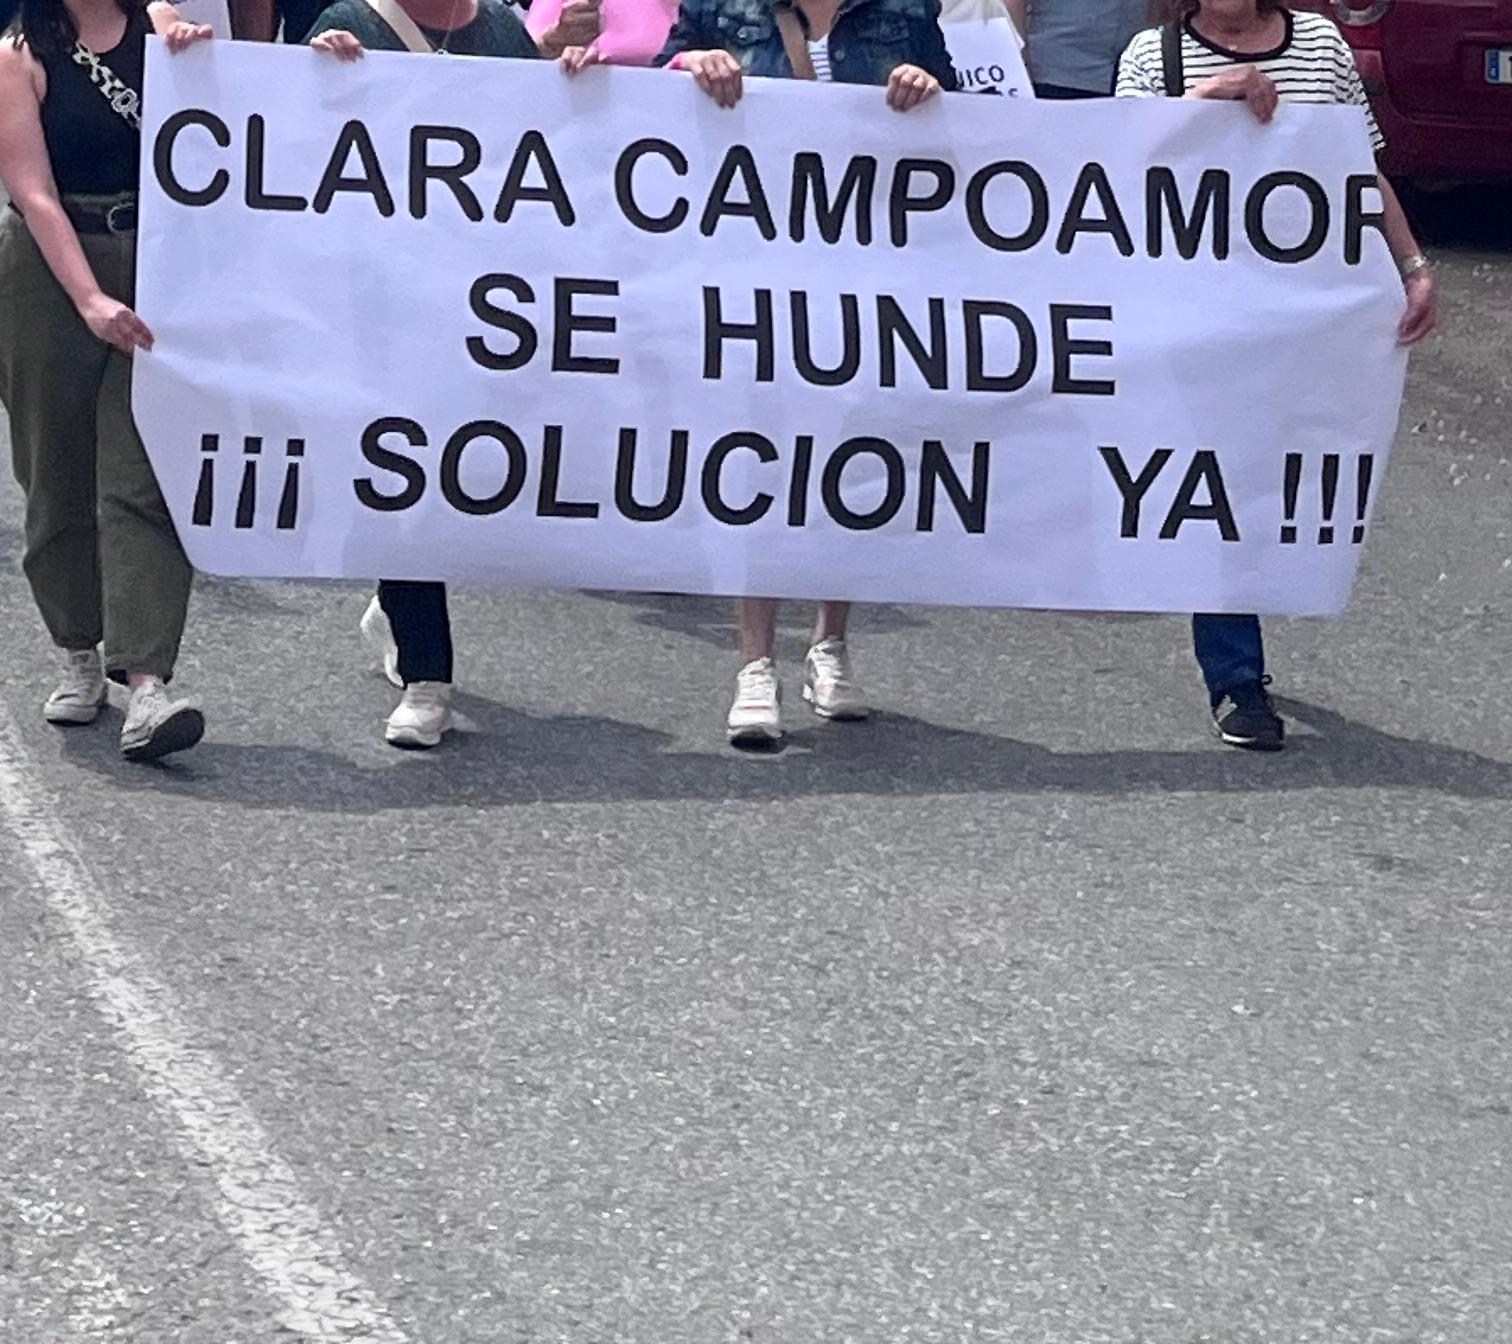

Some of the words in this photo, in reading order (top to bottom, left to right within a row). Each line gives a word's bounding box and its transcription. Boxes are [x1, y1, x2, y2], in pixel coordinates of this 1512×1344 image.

[152, 108, 576, 228] CLARA
[464, 272, 621, 375] SE
[701, 284, 1117, 397] HUNDE
[352, 415, 992, 536] SOLUCION
[1096, 445, 1242, 543] YA
[1279, 451, 1375, 546] !!!
